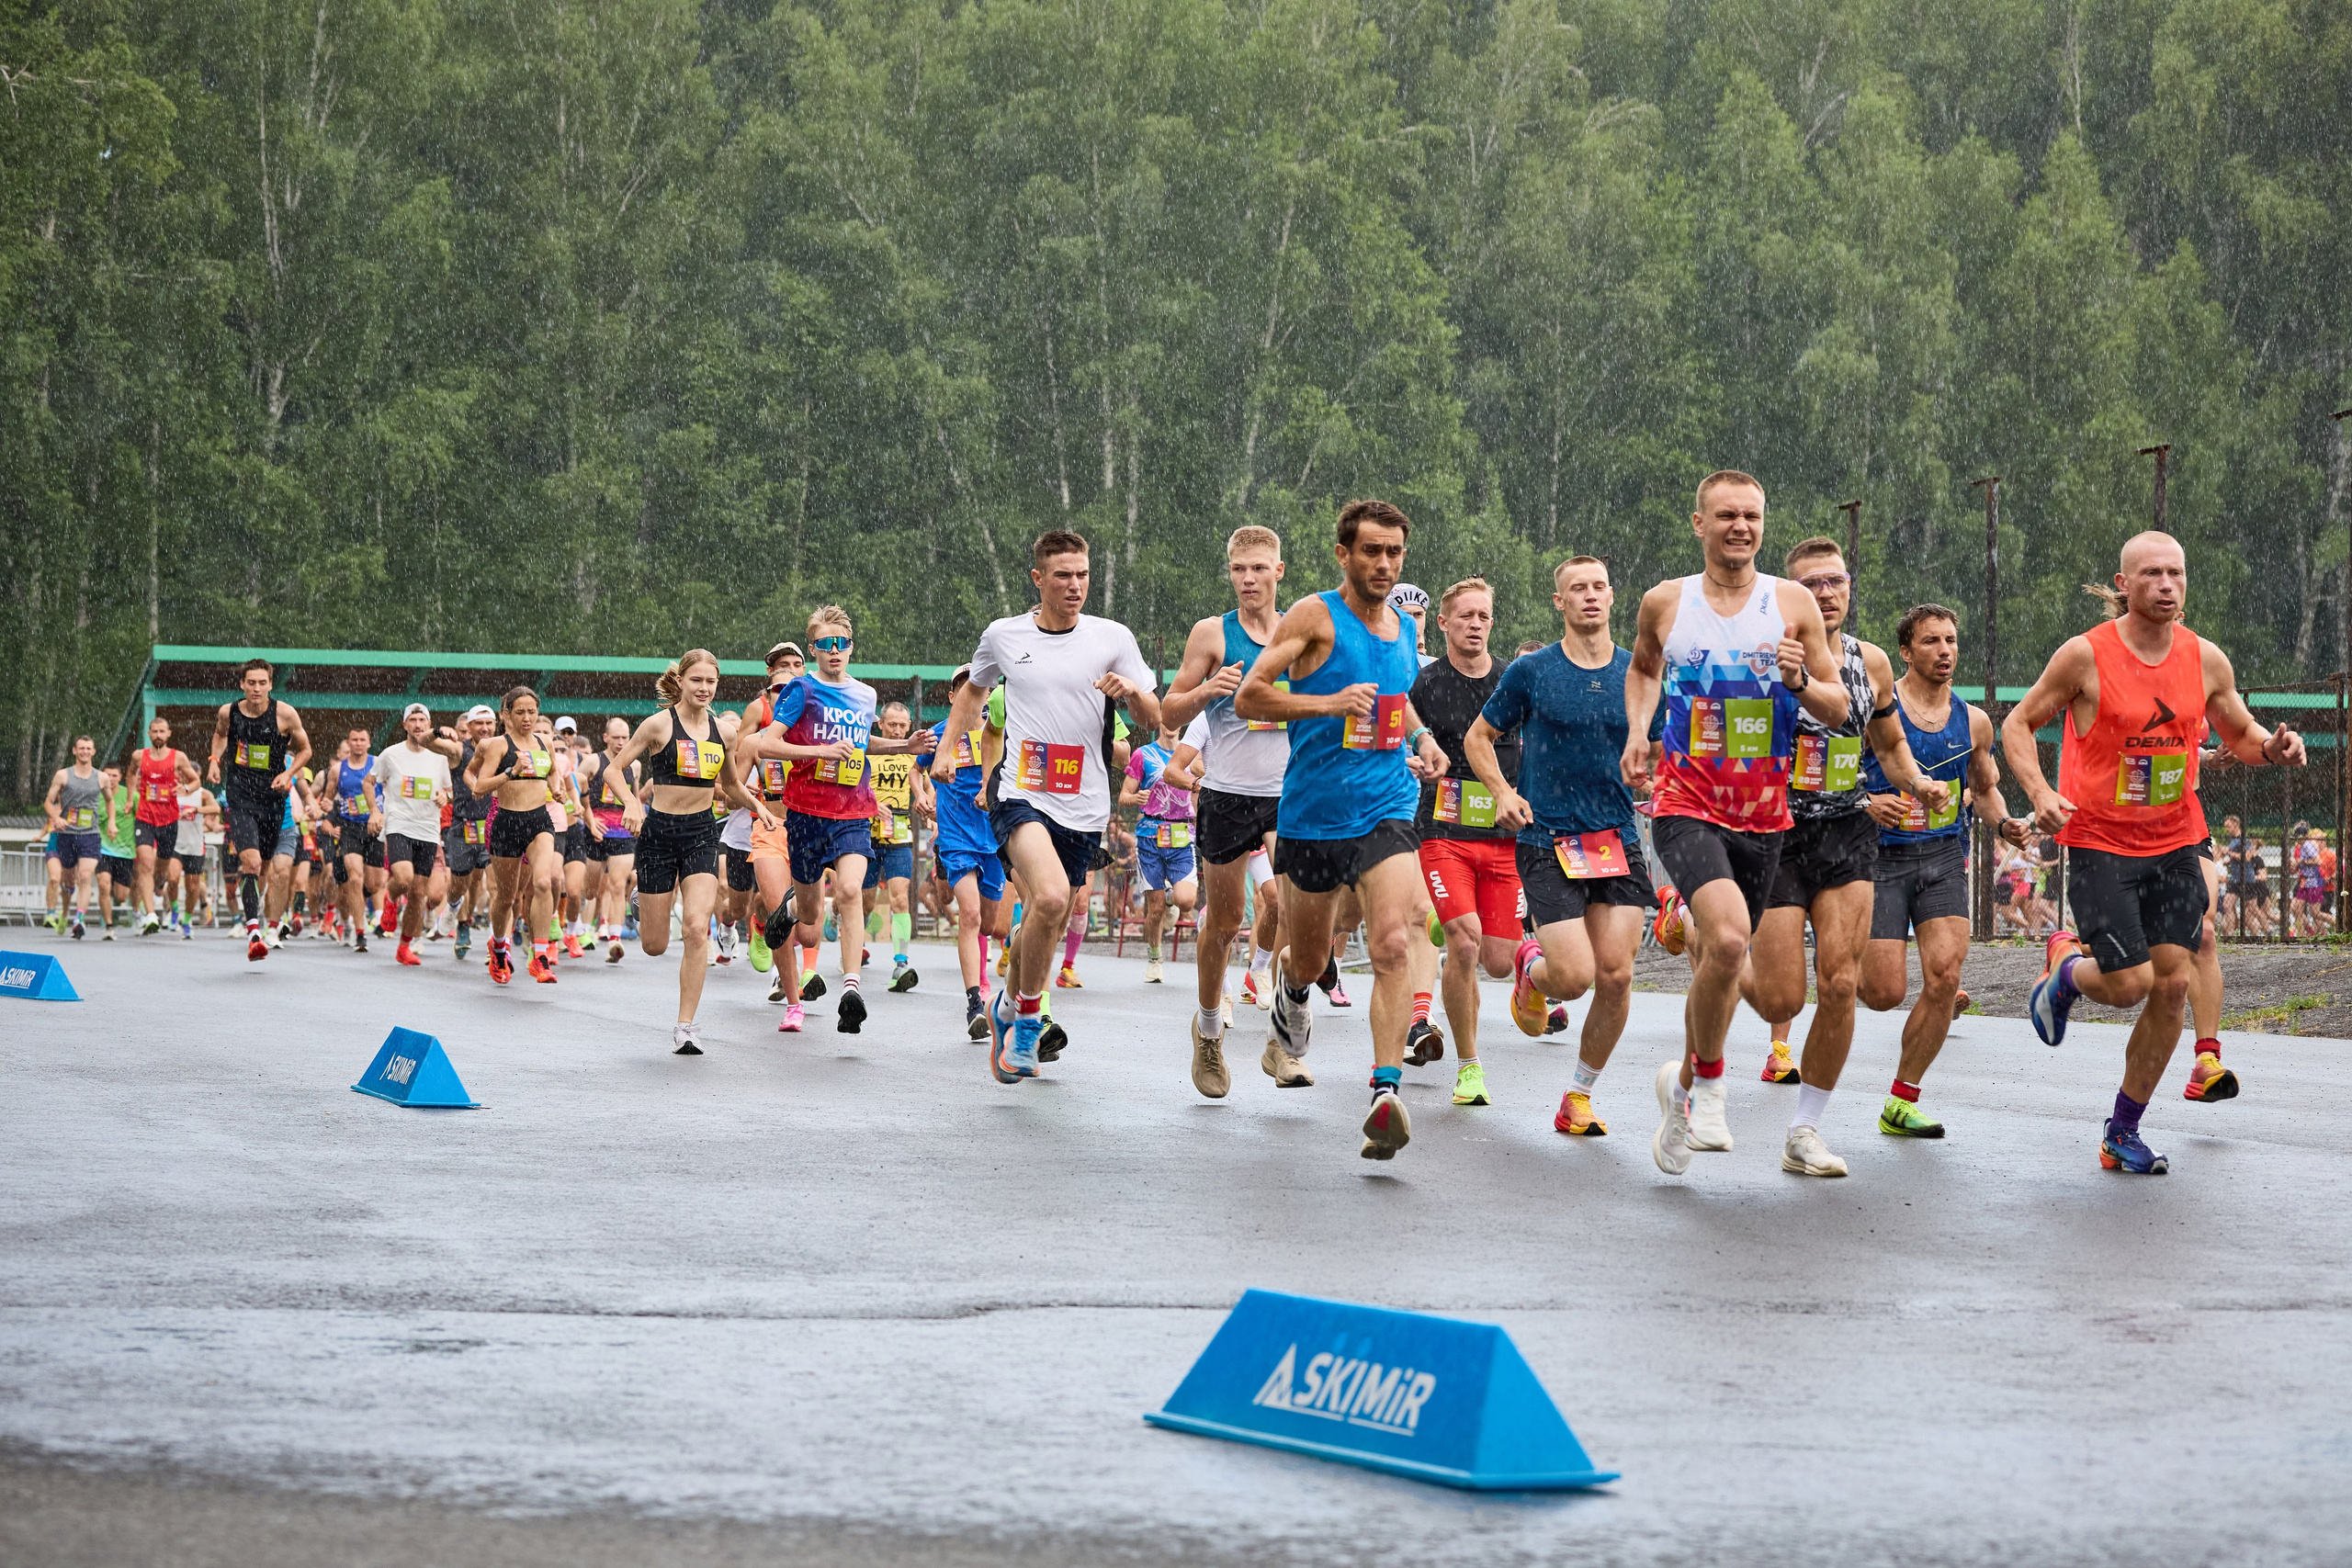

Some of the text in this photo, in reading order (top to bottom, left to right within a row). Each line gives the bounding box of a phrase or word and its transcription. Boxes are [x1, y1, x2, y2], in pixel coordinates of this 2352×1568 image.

[1395, 591, 1428, 606] DIIKE
[1760, 659, 1778, 667] TEA
[823, 705, 866, 728] КРОСС
[1388, 708, 1403, 728] 51
[1734, 716, 1768, 735] 166
[2124, 736, 2187, 748] DEMIX
[704, 752, 721, 765] 110
[845, 759, 862, 771] 105
[1833, 753, 1858, 770] 170
[877, 763, 908, 773] I LOVE
[1054, 758, 1080, 775] 116
[877, 773, 908, 788] MY
[2158, 768, 2184, 785] 187
[1467, 795, 1493, 810] 163
[1599, 845, 1613, 861] 2
